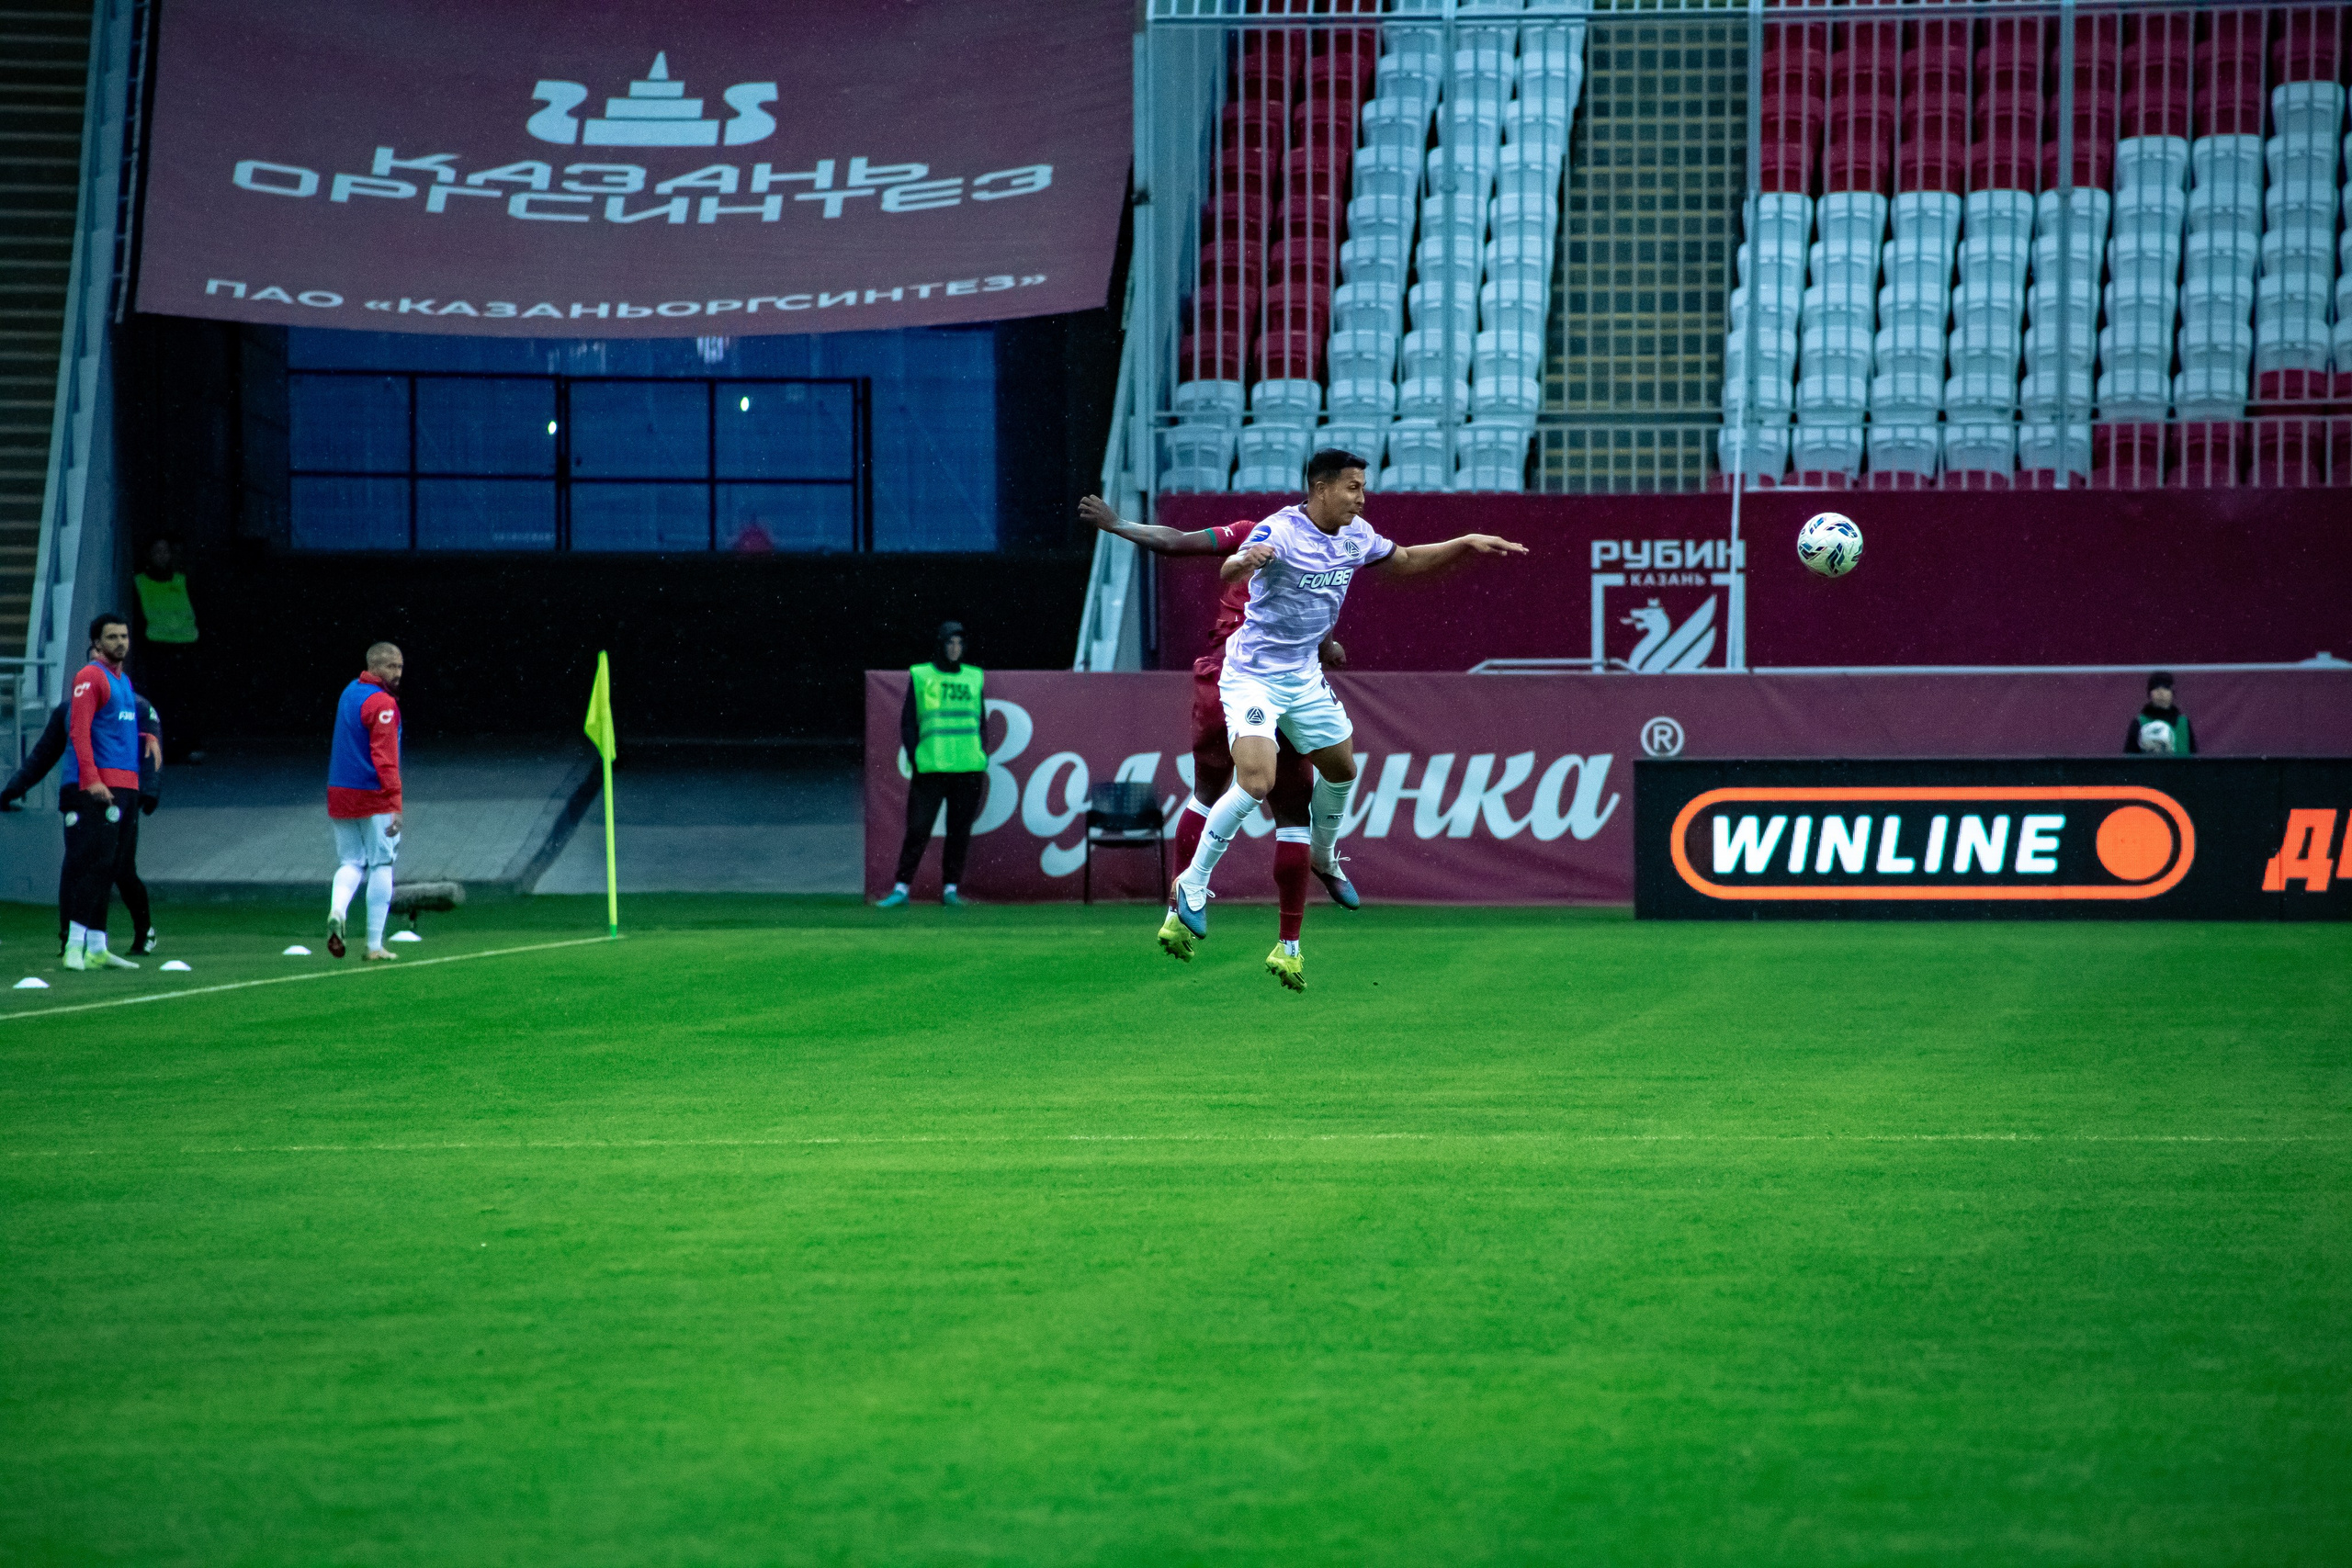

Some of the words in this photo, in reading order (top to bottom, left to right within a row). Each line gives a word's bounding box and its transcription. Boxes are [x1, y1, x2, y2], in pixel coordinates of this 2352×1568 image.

[232, 160, 1054, 224] ОРГСИНТЕЗ
[371, 146, 930, 195] КАЗАНЬ
[205, 278, 344, 308] ПАО
[364, 275, 1047, 319] «КАЗАНЬОРГСИНТЕЗ»
[1591, 539, 1746, 570] РУБИН
[1297, 568, 1355, 589] FONBE
[1630, 573, 1706, 586] КАЗАНЬ
[1713, 815, 2067, 874] WINLINE
[2262, 808, 2352, 891] Д
